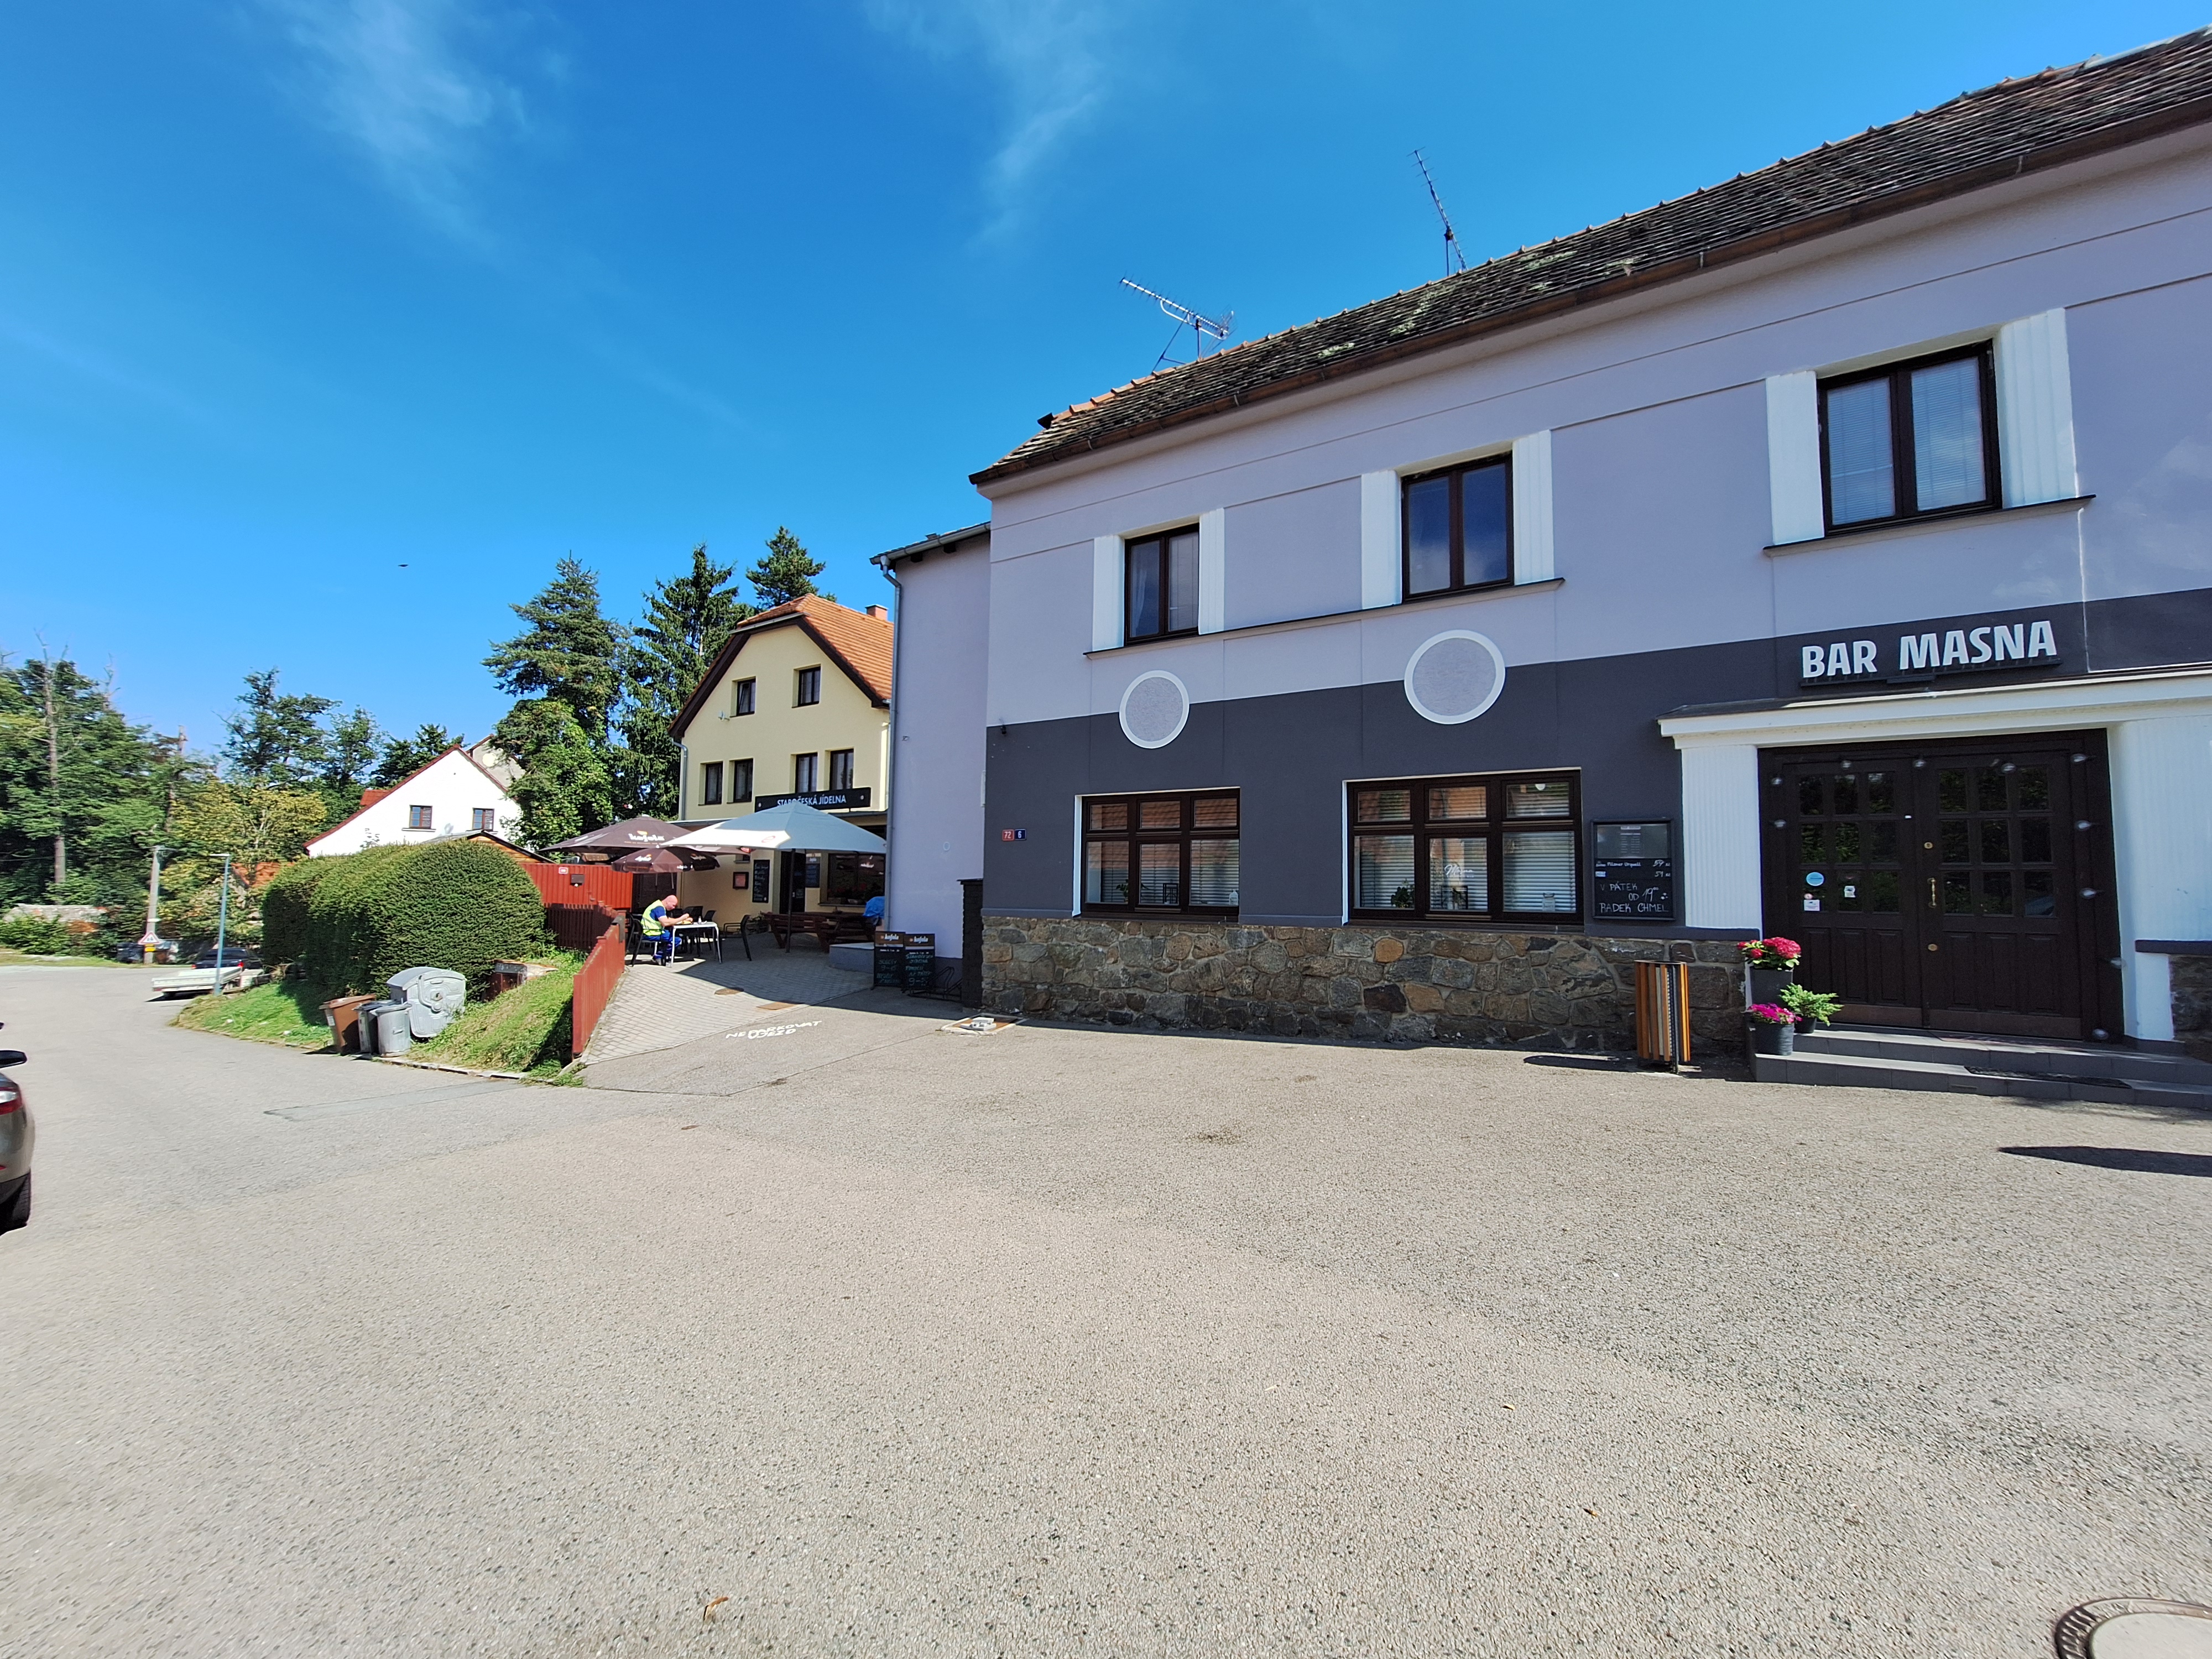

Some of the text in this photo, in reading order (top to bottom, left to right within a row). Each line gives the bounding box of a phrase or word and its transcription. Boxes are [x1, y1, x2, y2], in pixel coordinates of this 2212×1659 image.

[1802, 620, 2058, 679] BAR MASNA
[818, 794, 847, 805] JÍDELNA
[1004, 831, 1012, 839] 72
[1018, 830, 1022, 839] 6
[1610, 881, 1637, 891] PÁTEK
[1628, 893, 1639, 901] OD
[1599, 902, 1669, 913] RADEK CHMEL
